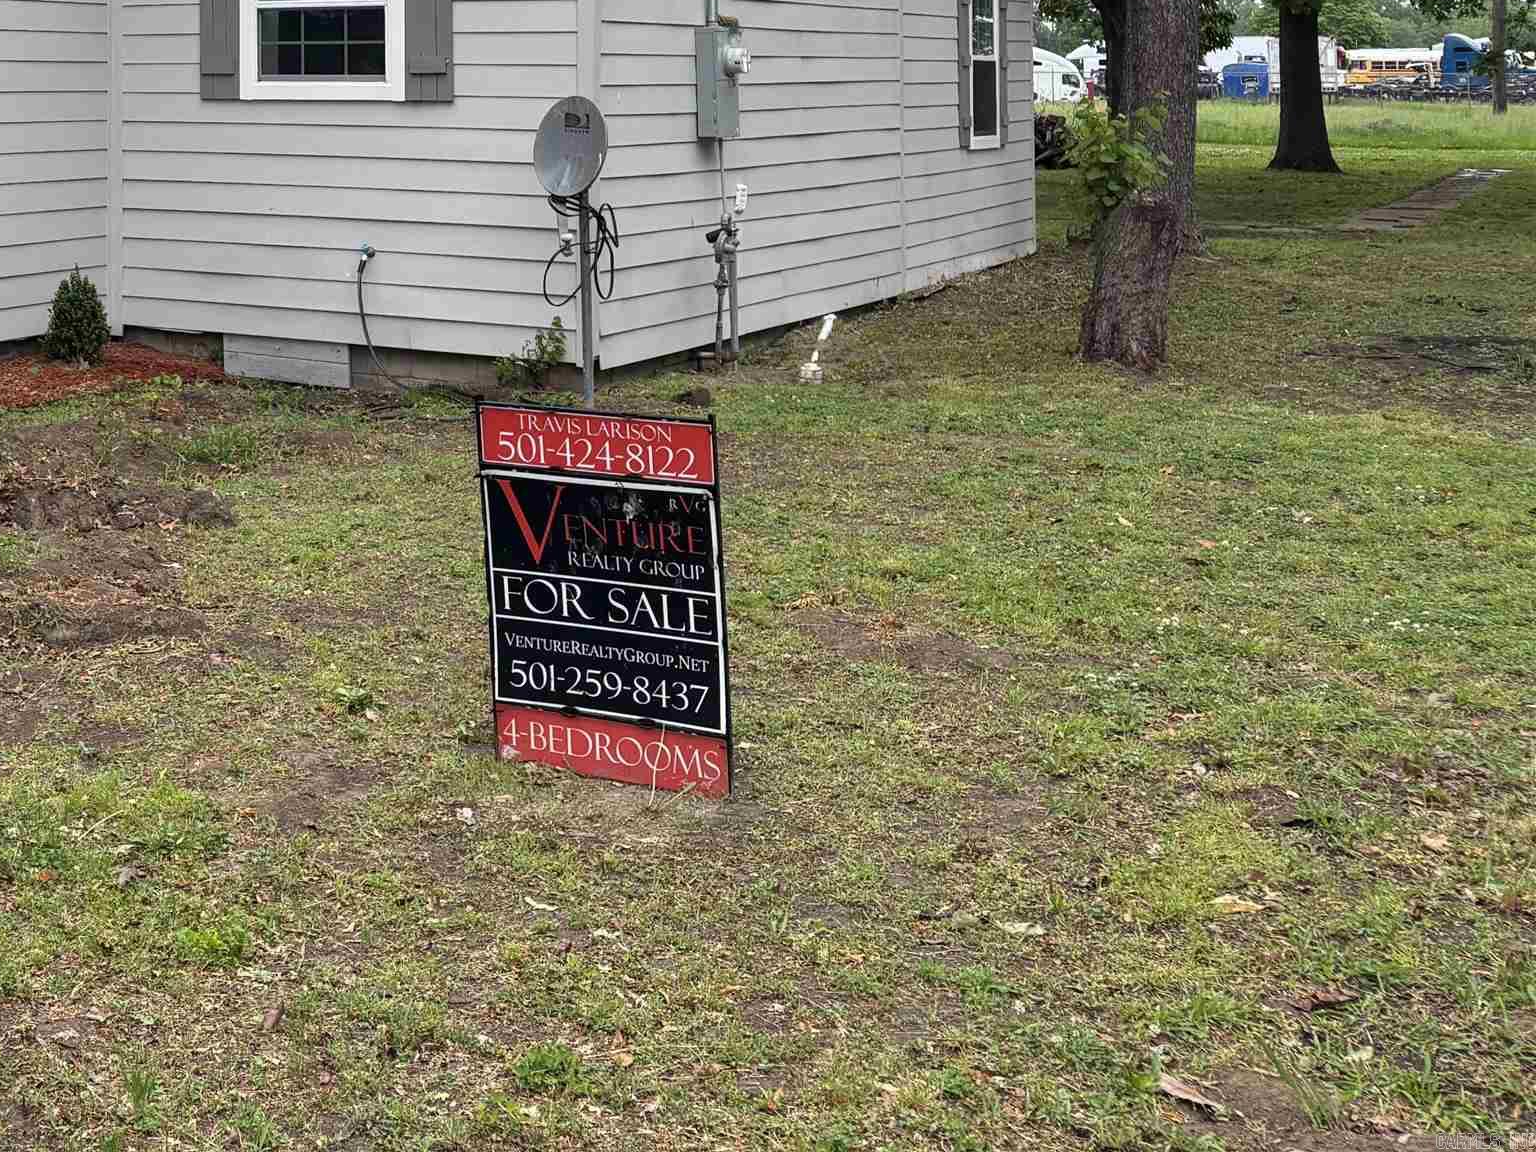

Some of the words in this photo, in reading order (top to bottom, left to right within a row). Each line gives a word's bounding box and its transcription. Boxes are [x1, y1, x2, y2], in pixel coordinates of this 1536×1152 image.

[518, 414, 580, 434] TRAVIS
[587, 420, 672, 441] LARISON
[497, 432, 698, 479] 501-424-8122
[496, 480, 707, 564] VENTURE
[568, 552, 635, 573] REALTY
[639, 559, 705, 580] GROUP
[502, 575, 595, 620] FOR
[608, 588, 713, 635] SALE
[510, 660, 710, 713] 501-259-8437
[504, 718, 721, 781] 4-BEDROOMS
